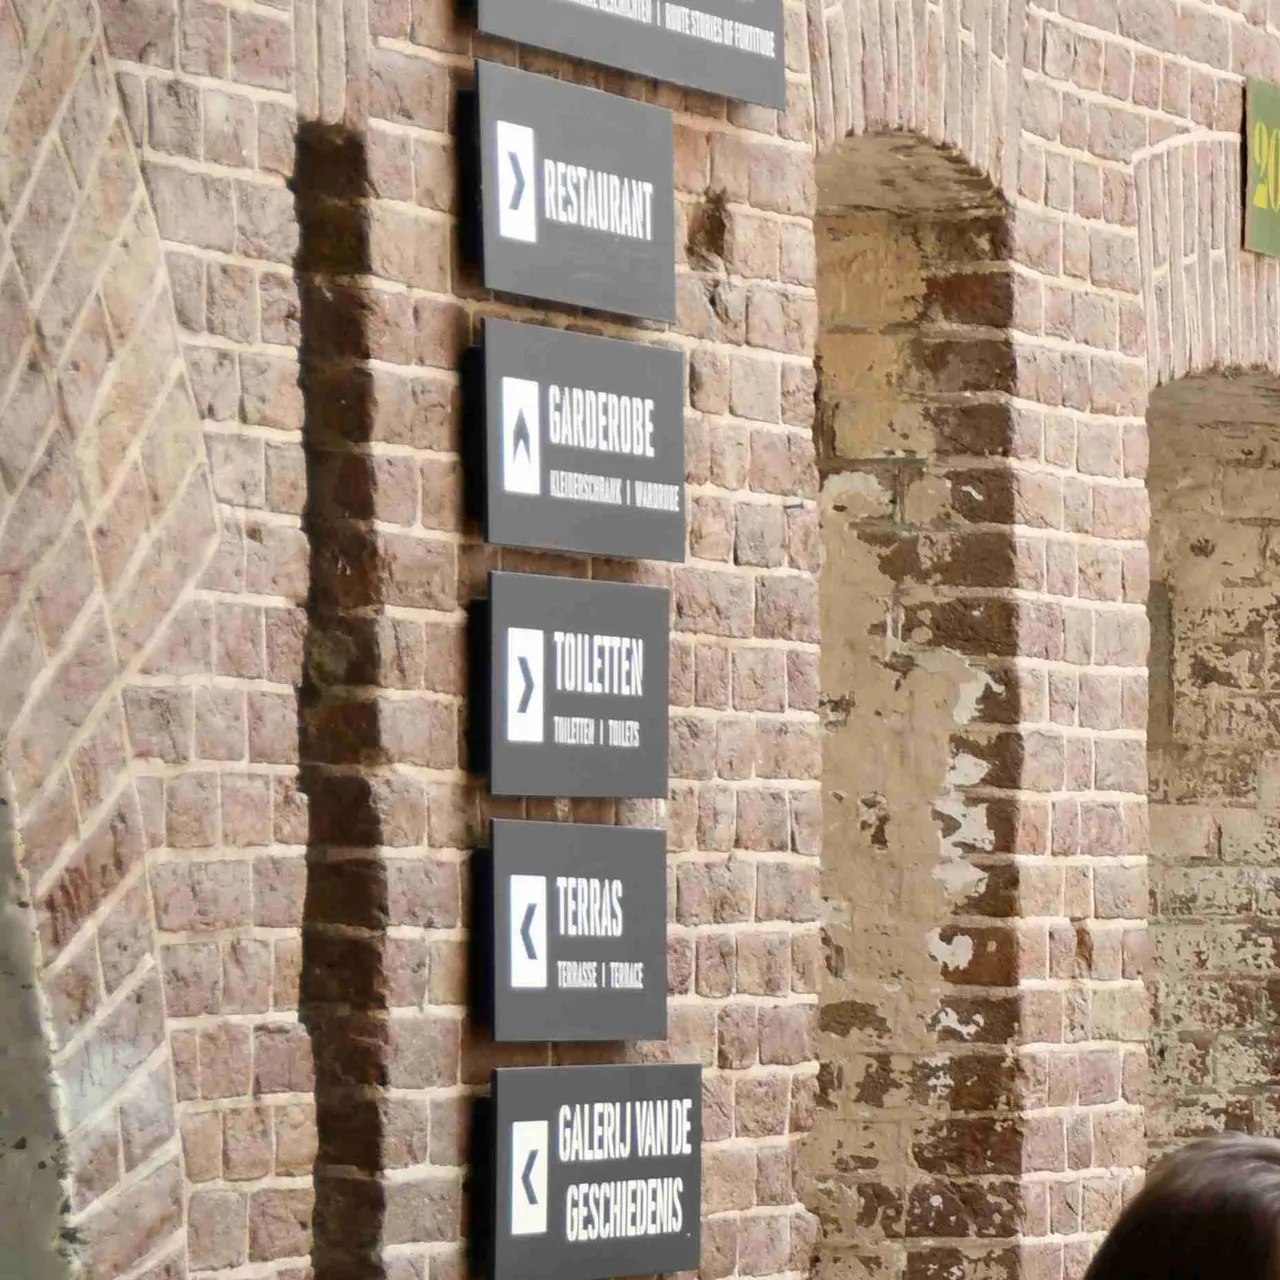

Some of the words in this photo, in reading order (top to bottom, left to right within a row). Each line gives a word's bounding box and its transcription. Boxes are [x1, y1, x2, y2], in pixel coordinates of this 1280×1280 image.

[665, 3, 690, 35] ROUTE
[544, 159, 653, 240] RESTAURANT
[549, 385, 654, 457] GARDEROBE
[554, 632, 643, 696] TOILETTEN
[554, 716, 594, 744] TOILETTEN
[608, 720, 639, 747] TOILETS
[556, 877, 622, 936] TERRAS
[557, 961, 597, 988] TERRASSE
[610, 962, 643, 989] TERRACE
[559, 1102, 631, 1161] GALERIJ
[636, 1100, 668, 1156] VAN
[672, 1099, 692, 1155] DE
[566, 1177, 683, 1241] GESCHIEDENIS
